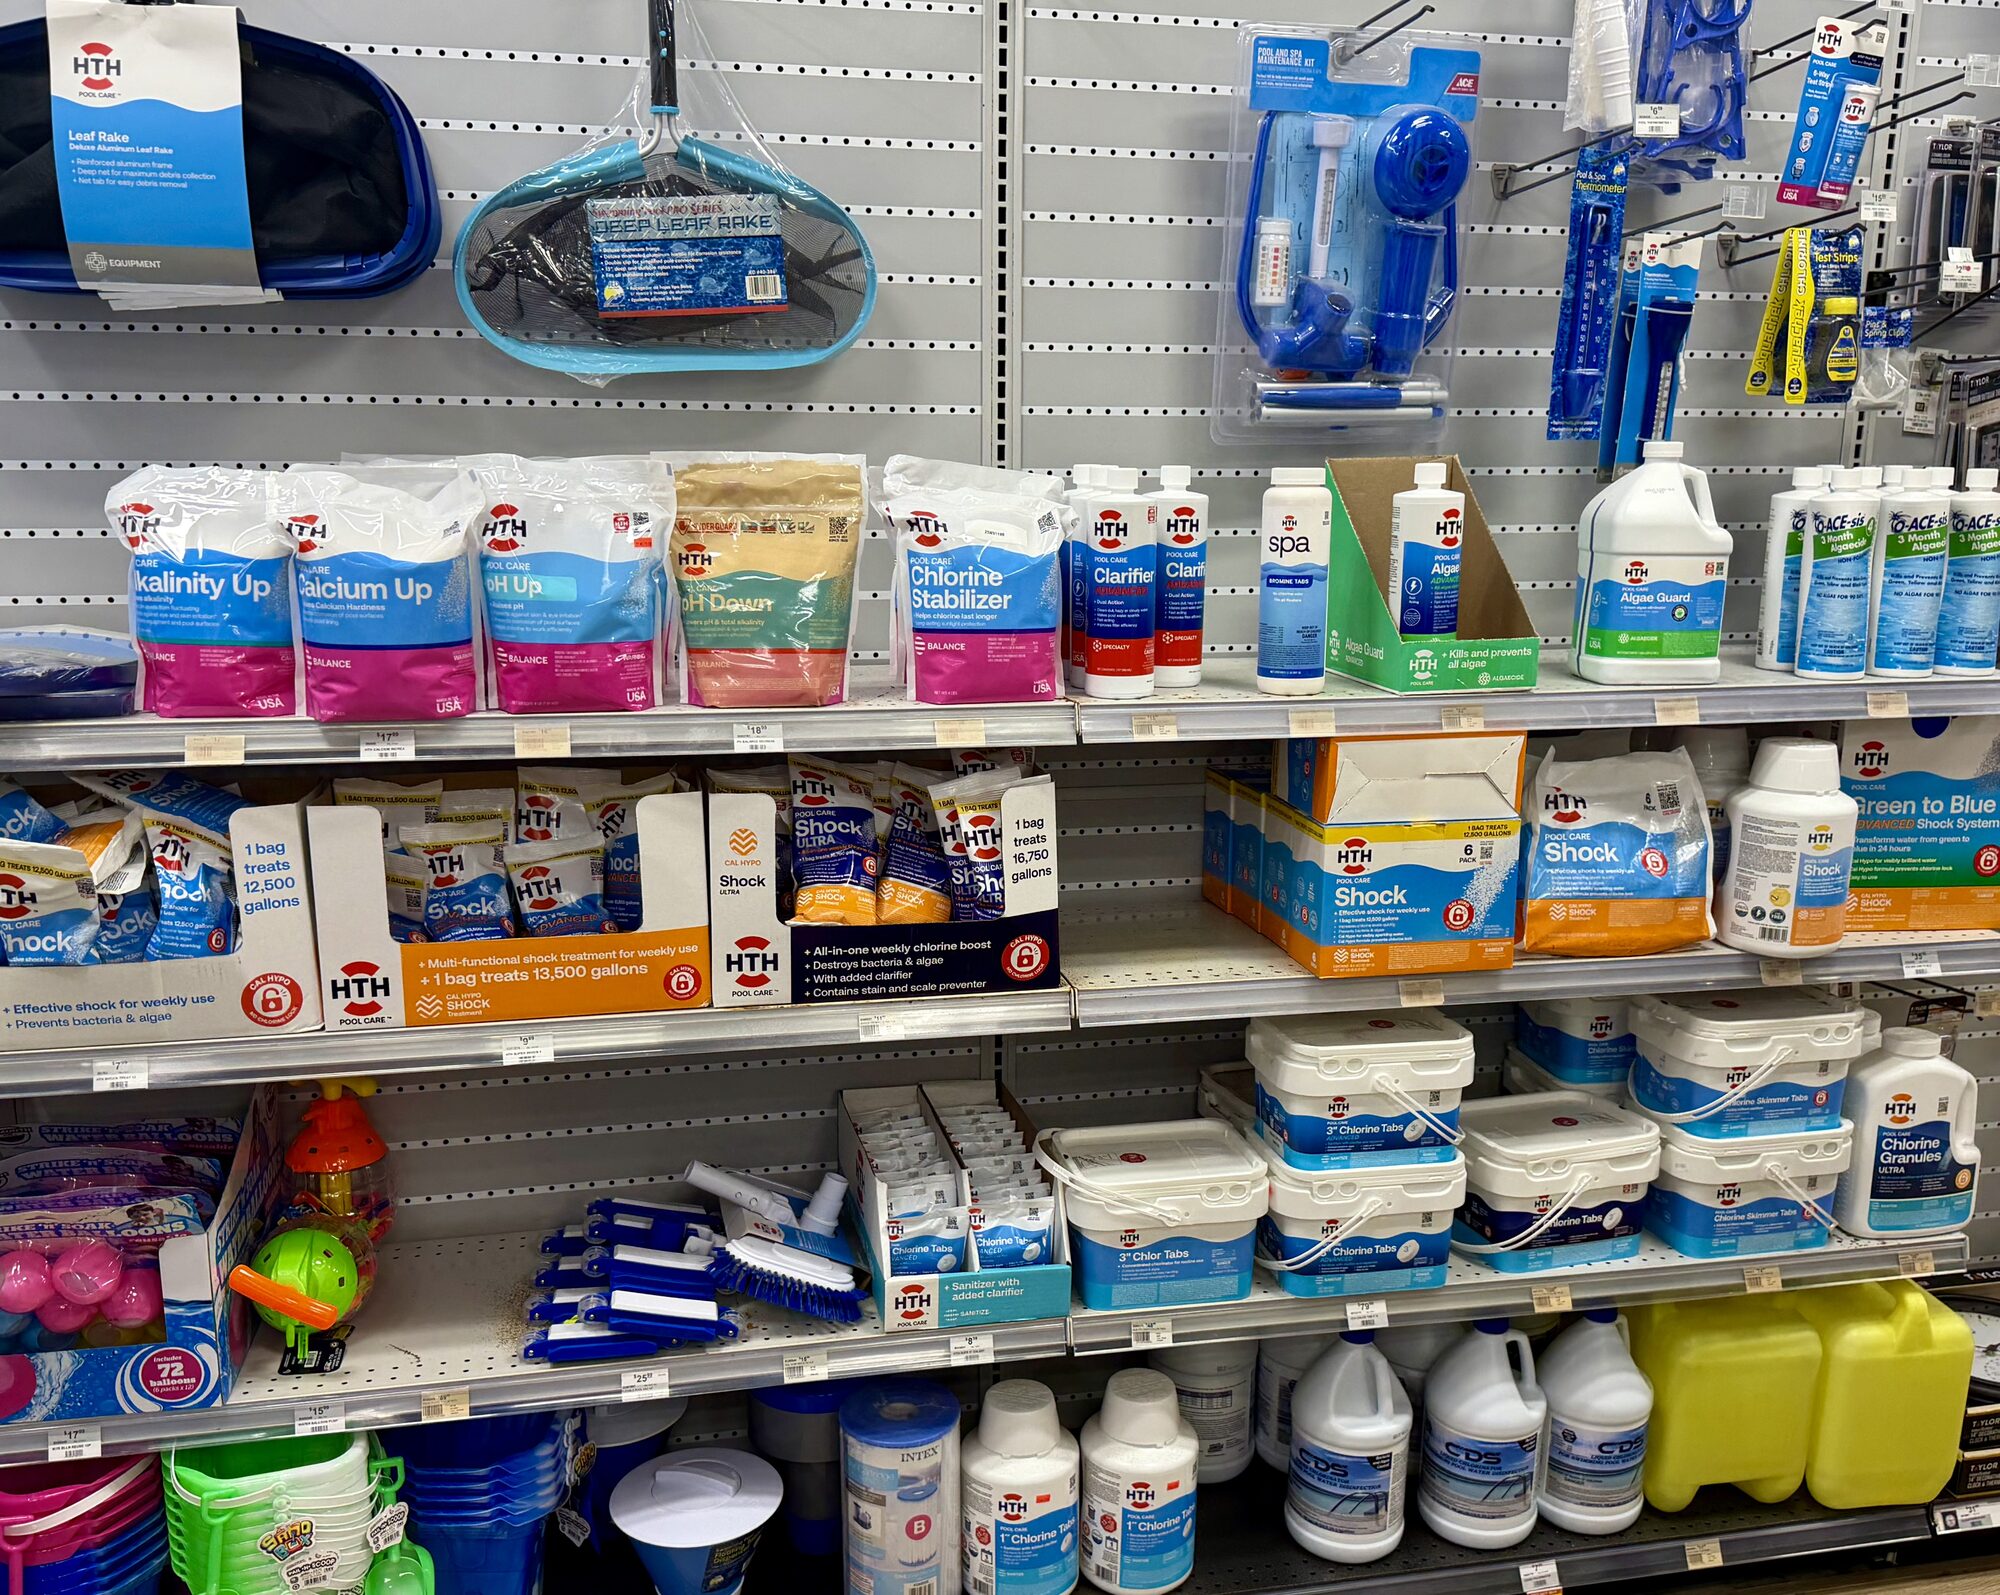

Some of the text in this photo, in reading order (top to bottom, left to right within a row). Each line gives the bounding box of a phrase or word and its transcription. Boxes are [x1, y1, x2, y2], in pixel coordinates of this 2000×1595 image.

[1258, 48, 1302, 59] POOL AND SPA
[1258, 55, 1315, 66] MAINTENANCE KIT
[73, 57, 121, 76] HTH
[1456, 78, 1474, 87] ACE
[68, 130, 129, 143] Leaf Rake
[69, 143, 95, 151] Deluxe
[97, 145, 135, 153] Aluminum
[76, 158, 173, 169] Reinforced aluminum frame
[78, 168, 97, 176] Deep
[159, 171, 181, 179] debris
[183, 172, 216, 180] collection
[1576, 170, 1588, 178] Pool
[1593, 173, 1606, 181] Spa
[118, 179, 134, 188] easy
[136, 179, 158, 187] debris
[159, 180, 188, 188] removal
[1575, 180, 1627, 194] Thermometer
[1783, 191, 1797, 201] USA
[594, 214, 772, 233] DEEP LEAF RAKE
[109, 259, 161, 268] EQUIPMENT
[1797, 229, 1806, 295] CHLORINE
[1814, 252, 1858, 264] Test Strips
[1898, 531, 1941, 543] 3 Month
[1268, 535, 1310, 558] spa
[911, 565, 1003, 586] Chlorine
[1094, 567, 1154, 585] Clarifier
[487, 578, 543, 595] pH Up
[682, 593, 774, 612] pH Down
[911, 588, 1012, 610] Stabilizer
[1620, 593, 1691, 603] Algae Guard
[316, 602, 386, 611] Calcium Hardness
[915, 612, 933, 621] Helps
[934, 612, 960, 620] chlorine
[975, 613, 998, 622] longer
[927, 642, 966, 651] BALANCE
[1449, 648, 1532, 660] Kills and prevents
[312, 658, 351, 669] BALANCE
[1410, 658, 1437, 671] HTH
[1448, 659, 1487, 670] all algae
[1492, 673, 1524, 681] ALGAECIDE
[1857, 795, 1996, 814] Green to Blue
[1015, 818, 1044, 831] 1 bag
[1014, 833, 1047, 847] treats
[1463, 830, 1511, 839] 12,500 GALLONS
[245, 842, 286, 856] 1 bag
[1464, 844, 1474, 855] 6
[1545, 842, 1619, 863] Shock
[1012, 850, 1049, 865] 16,750
[1459, 856, 1477, 864] PACK
[244, 861, 290, 875] treats
[1011, 865, 1052, 883] gallons
[1803, 864, 1841, 877] Shock
[244, 876, 295, 894] 12,500
[719, 875, 765, 888] Shock
[1334, 885, 1407, 907] Shock
[244, 896, 300, 915] gallons
[813, 940, 992, 957] All-in-one weekly chlorine boost
[428, 943, 699, 970] Multi-functional shock treatment for weekly use
[726, 953, 778, 972] HTH
[813, 956, 944, 971] Destroys bacteria & algae
[249, 975, 291, 990] CAL HYPO
[434, 963, 648, 988] 1 bag treats 13,500 gallons
[813, 969, 913, 984] With added clarifier
[331, 977, 390, 1000] HTH
[813, 979, 987, 998] Contains stain and scale preventer
[14, 994, 215, 1015] Effective shock for weekly use
[447, 998, 490, 1010] SHOCK
[1339, 1124, 1380, 1134] Chlorine
[1381, 1123, 1404, 1132] Tabs
[1881, 1136, 1940, 1150] Chlorine
[1880, 1150, 1942, 1164] Granules
[1878, 1166, 1905, 1174] ULTRA
[1714, 1209, 1797, 1223] Chlorine Skimmer Tabs
[892, 1245, 952, 1255] Chlorine Tabs
[952, 1278, 1020, 1291] Sanitizer with
[894, 1294, 931, 1310] HTH
[960, 1309, 990, 1317] SANITIZE
[157, 1363, 184, 1378] 72
[149, 1377, 196, 1387] balloons
[901, 1448, 937, 1463] INTEX
[1300, 1448, 1348, 1475] CDS
[260, 1520, 313, 1552] SAND
